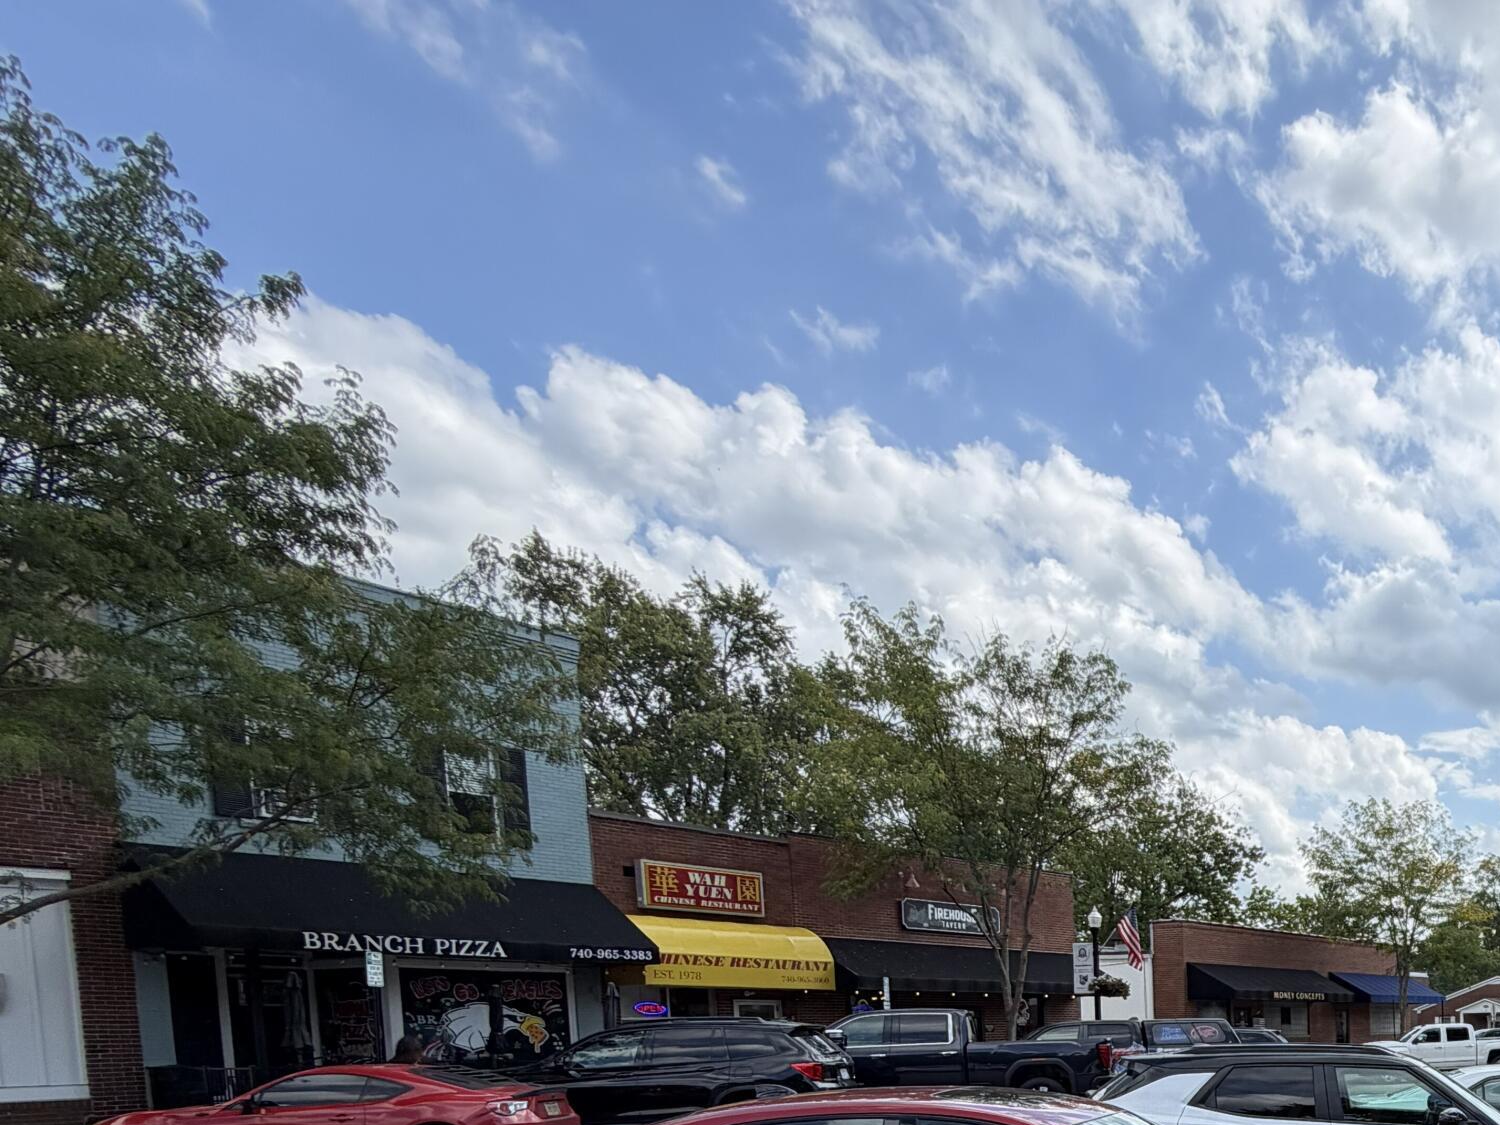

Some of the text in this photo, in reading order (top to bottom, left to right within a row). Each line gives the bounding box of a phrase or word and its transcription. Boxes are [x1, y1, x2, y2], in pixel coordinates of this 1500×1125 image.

[650, 866, 679, 896] 華
[687, 871, 727, 887] WAH
[684, 884, 733, 900] YUEN
[737, 876, 761, 903] 園
[653, 895, 760, 912] CHINESE RESTAURANT
[942, 920, 967, 930] TAVERN
[302, 931, 508, 958] BRANCH PIZZA
[569, 947, 653, 960] 740-965-3383
[660, 953, 832, 972] HINESE RESTAURANT
[679, 970, 702, 981] 1978
[501, 979, 563, 1001] EAGLES
[1273, 991, 1325, 1001] MONEY CONCEPTS
